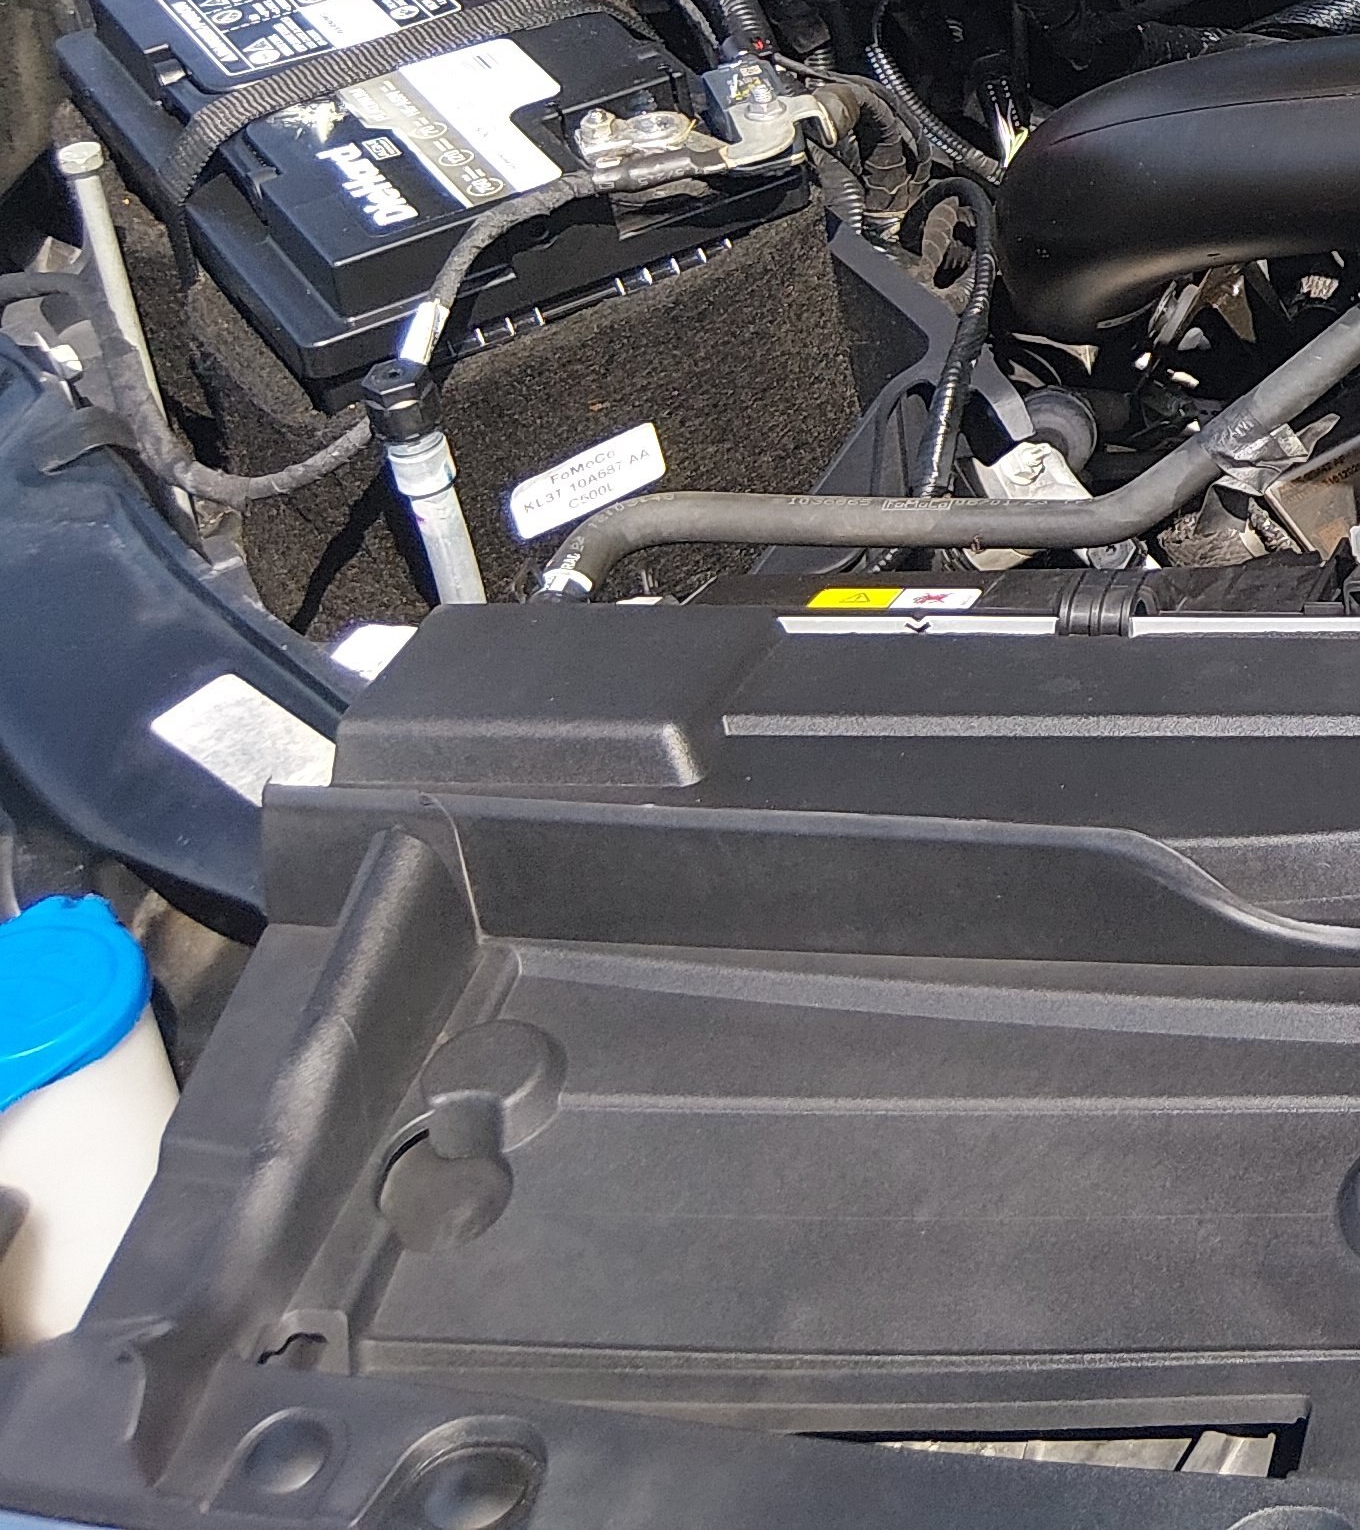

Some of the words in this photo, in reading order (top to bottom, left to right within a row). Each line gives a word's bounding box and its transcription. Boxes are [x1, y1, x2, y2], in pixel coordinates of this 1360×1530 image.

[316, 142, 419, 227] DieHard
[550, 450, 616, 484] FoMoCo
[629, 449, 650, 465] AA
